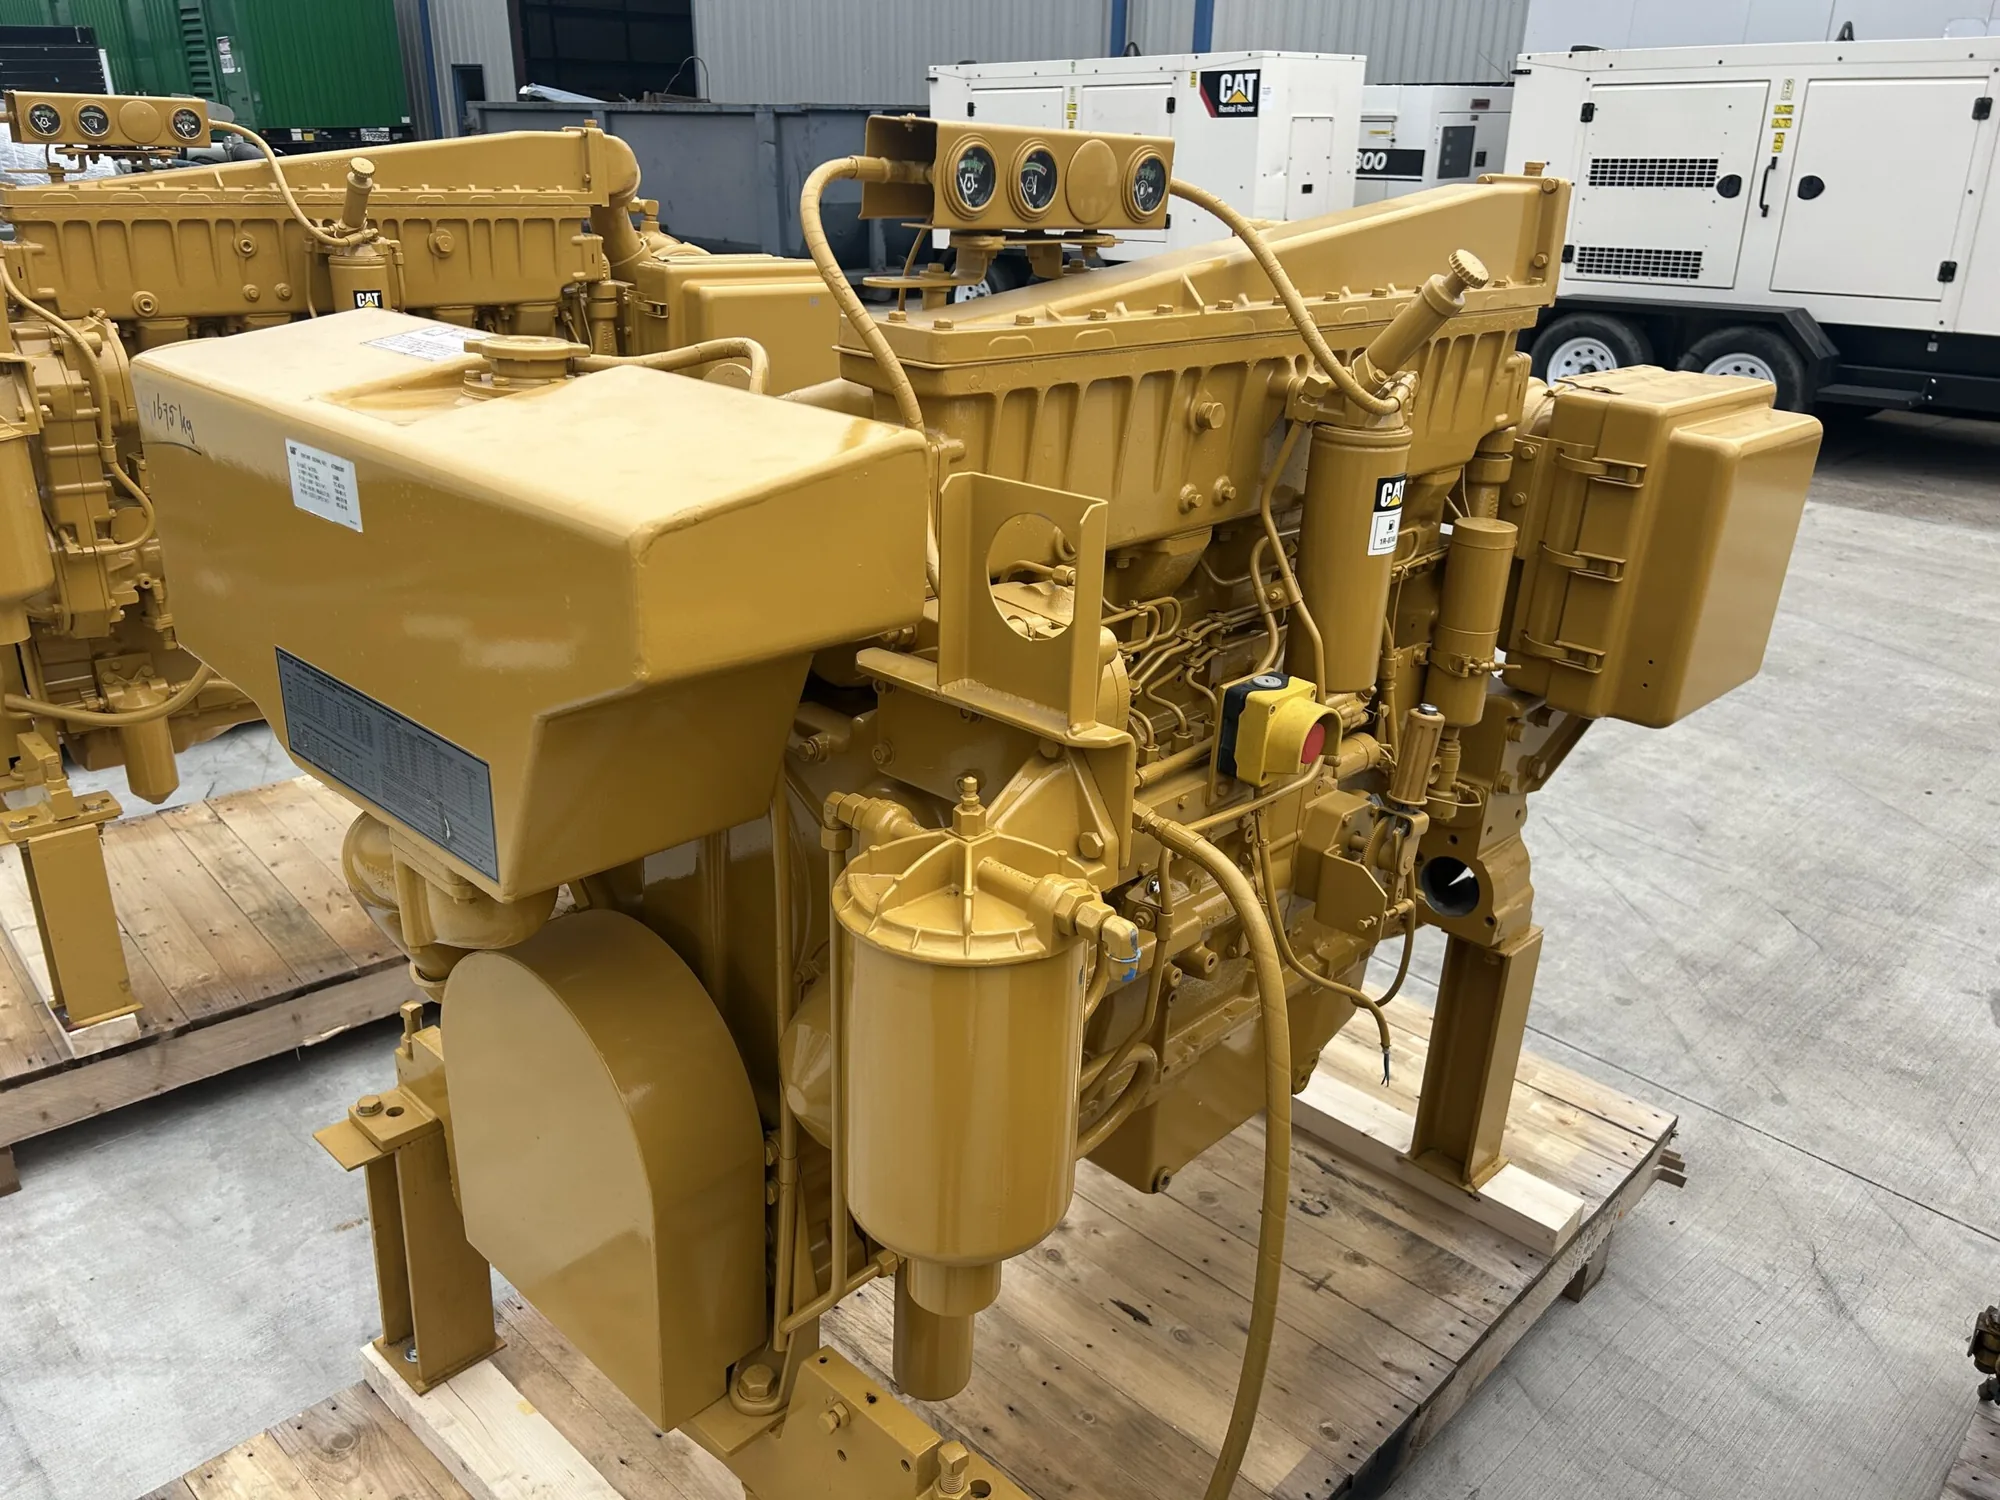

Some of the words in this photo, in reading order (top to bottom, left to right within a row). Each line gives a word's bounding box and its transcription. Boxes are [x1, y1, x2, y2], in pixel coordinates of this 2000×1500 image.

[1219, 73, 1257, 103] CAT
[1219, 104, 1236, 113] Rental
[1237, 104, 1255, 113] Power
[356, 292, 380, 307] CAT
[153, 393, 177, 431] 1675
[179, 403, 195, 445] kg
